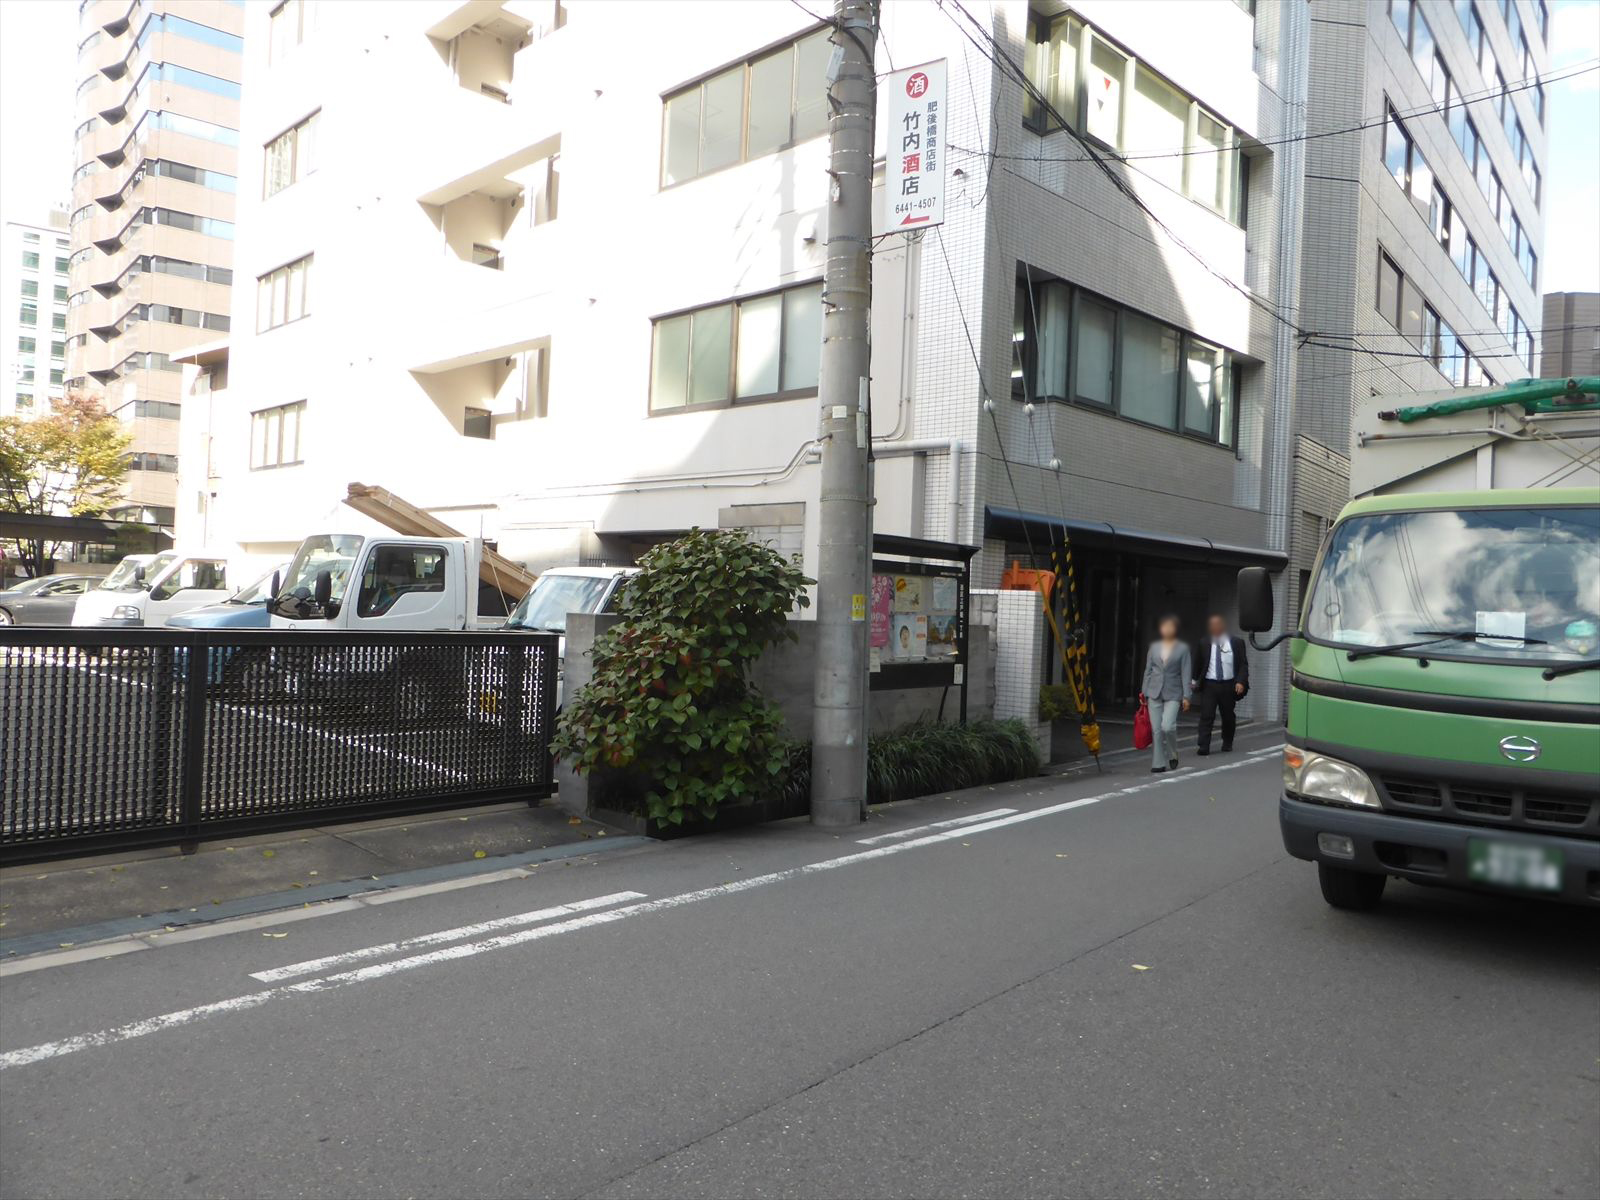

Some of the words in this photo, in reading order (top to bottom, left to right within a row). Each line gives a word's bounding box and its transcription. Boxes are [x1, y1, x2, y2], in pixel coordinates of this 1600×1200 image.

[909, 76, 924, 96] 酒
[902, 110, 921, 196] 竹内酒店
[925, 101, 938, 172] 肥後橋商店街
[895, 197, 936, 214] 6441-4507
